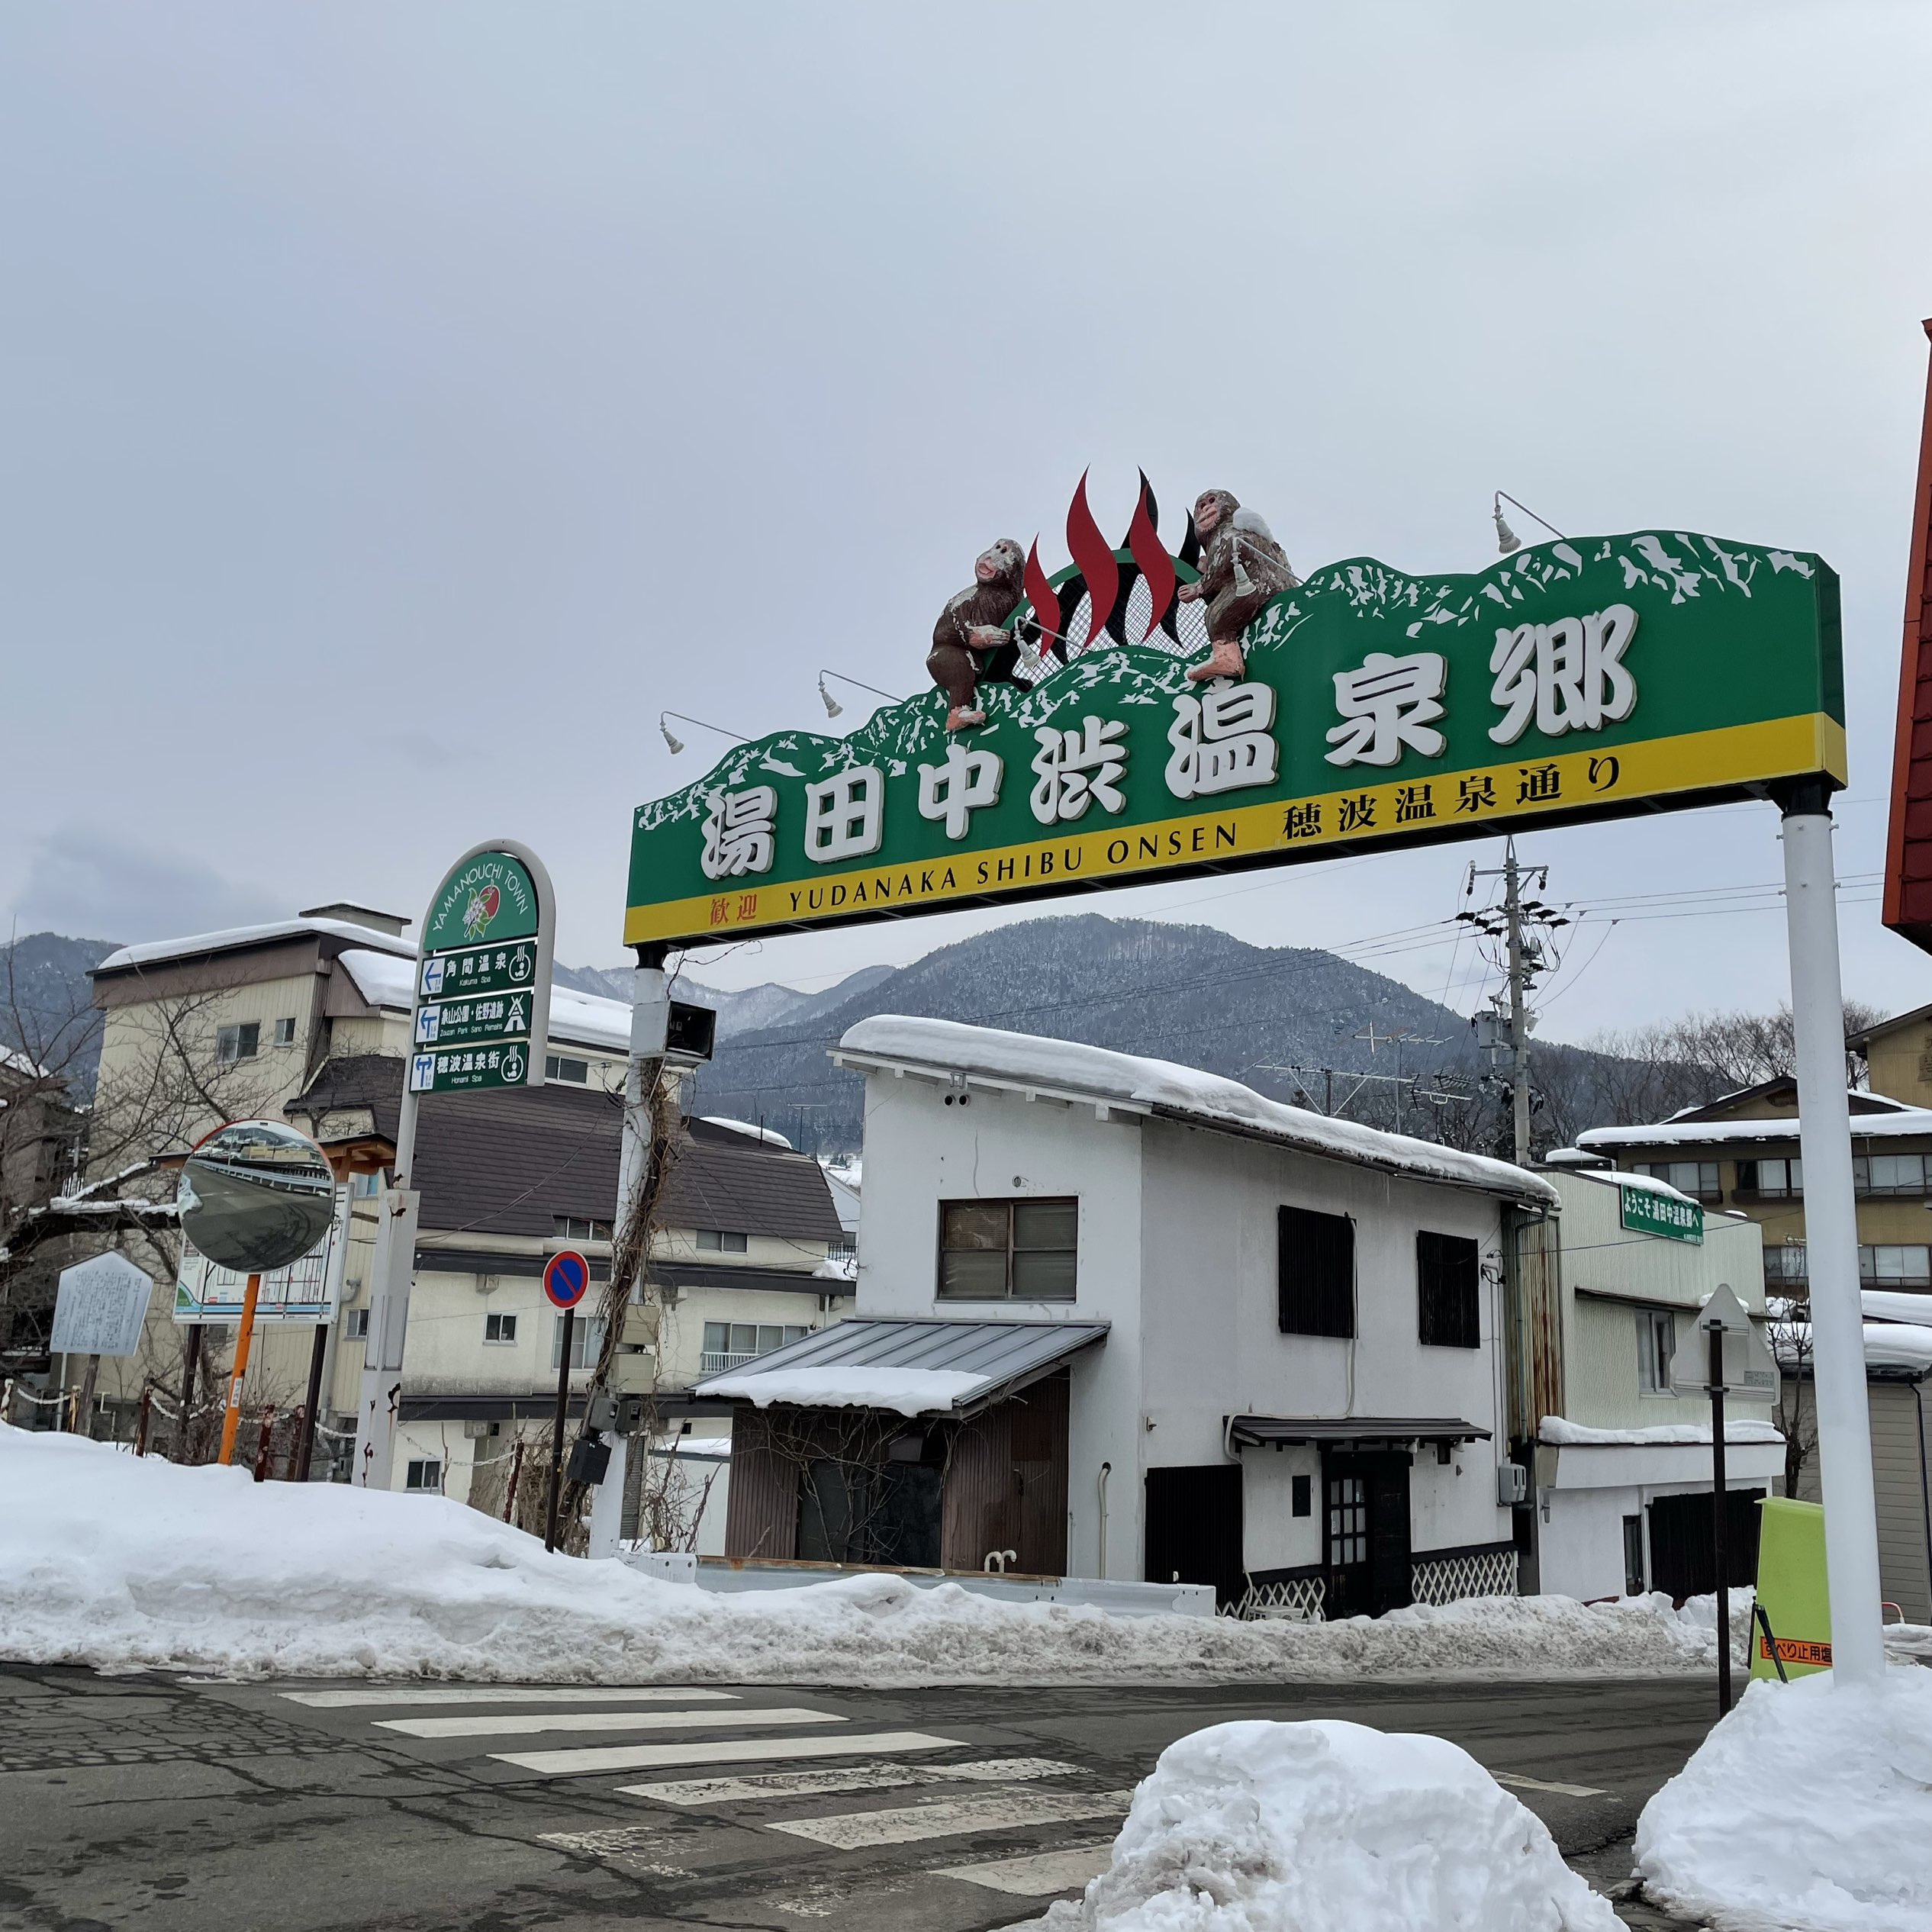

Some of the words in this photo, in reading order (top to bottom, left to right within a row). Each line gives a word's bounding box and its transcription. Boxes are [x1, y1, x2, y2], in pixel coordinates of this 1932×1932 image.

[700, 604, 1638, 881] 湯田中渋温泉郷
[1282, 755, 1620, 840] 穂波温泉通り
[789, 868, 956, 912] YUDANAKA
[977, 846, 1082, 884] SHIBU
[1107, 823, 1236, 864] ONSEN
[433, 863, 504, 932] YAMANOUCHI
[504, 870, 528, 915] TOWN
[710, 893, 758, 926] 歓迎
[446, 952, 507, 977] 角間温泉
[481, 976, 491, 984] Spa
[471, 1026, 482, 1034] Sano
[485, 1022, 503, 1032] Remains
[436, 1050, 501, 1074] 穂波温泉街
[451, 1075, 469, 1084] Honami
[472, 1074, 482, 1083] Spa
